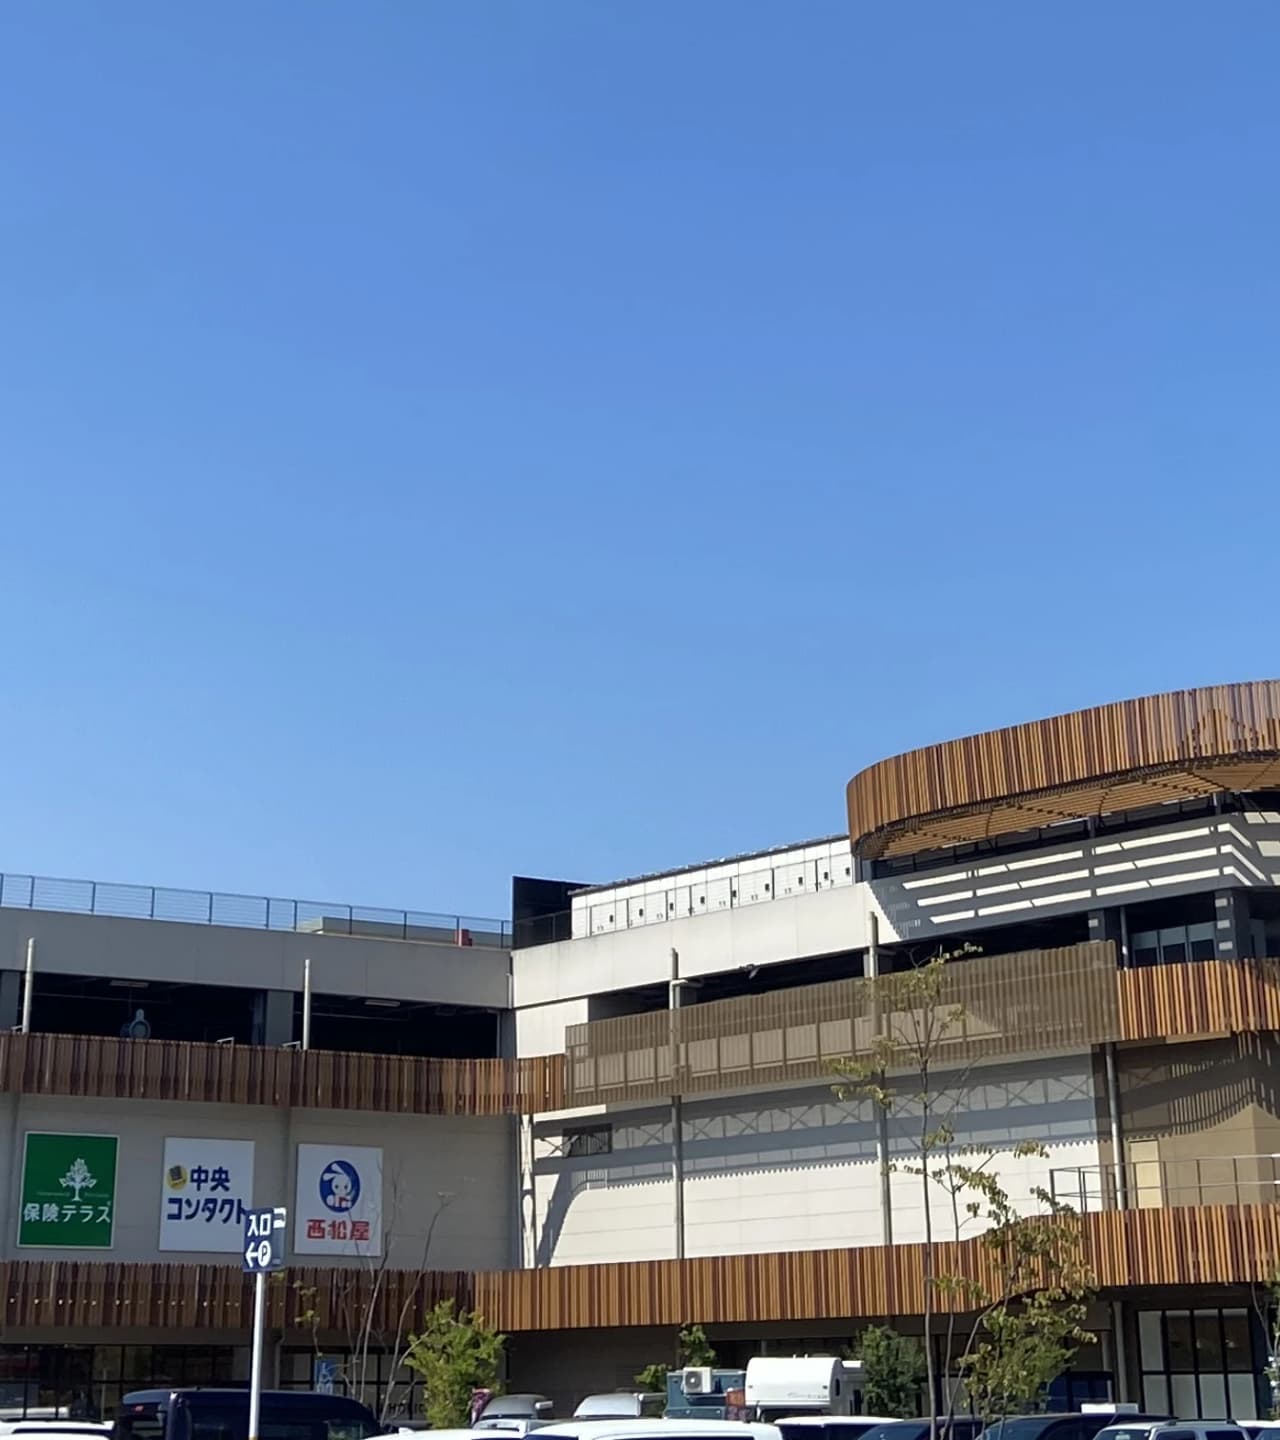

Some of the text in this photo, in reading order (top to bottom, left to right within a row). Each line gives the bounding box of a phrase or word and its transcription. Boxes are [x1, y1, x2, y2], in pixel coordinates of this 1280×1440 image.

[190, 1165, 231, 1192] 中央
[23, 1202, 111, 1224] 保険テラス
[167, 1197, 246, 1225] コンタクト
[247, 1213, 272, 1237] 入口
[306, 1218, 370, 1241] 西松屋
